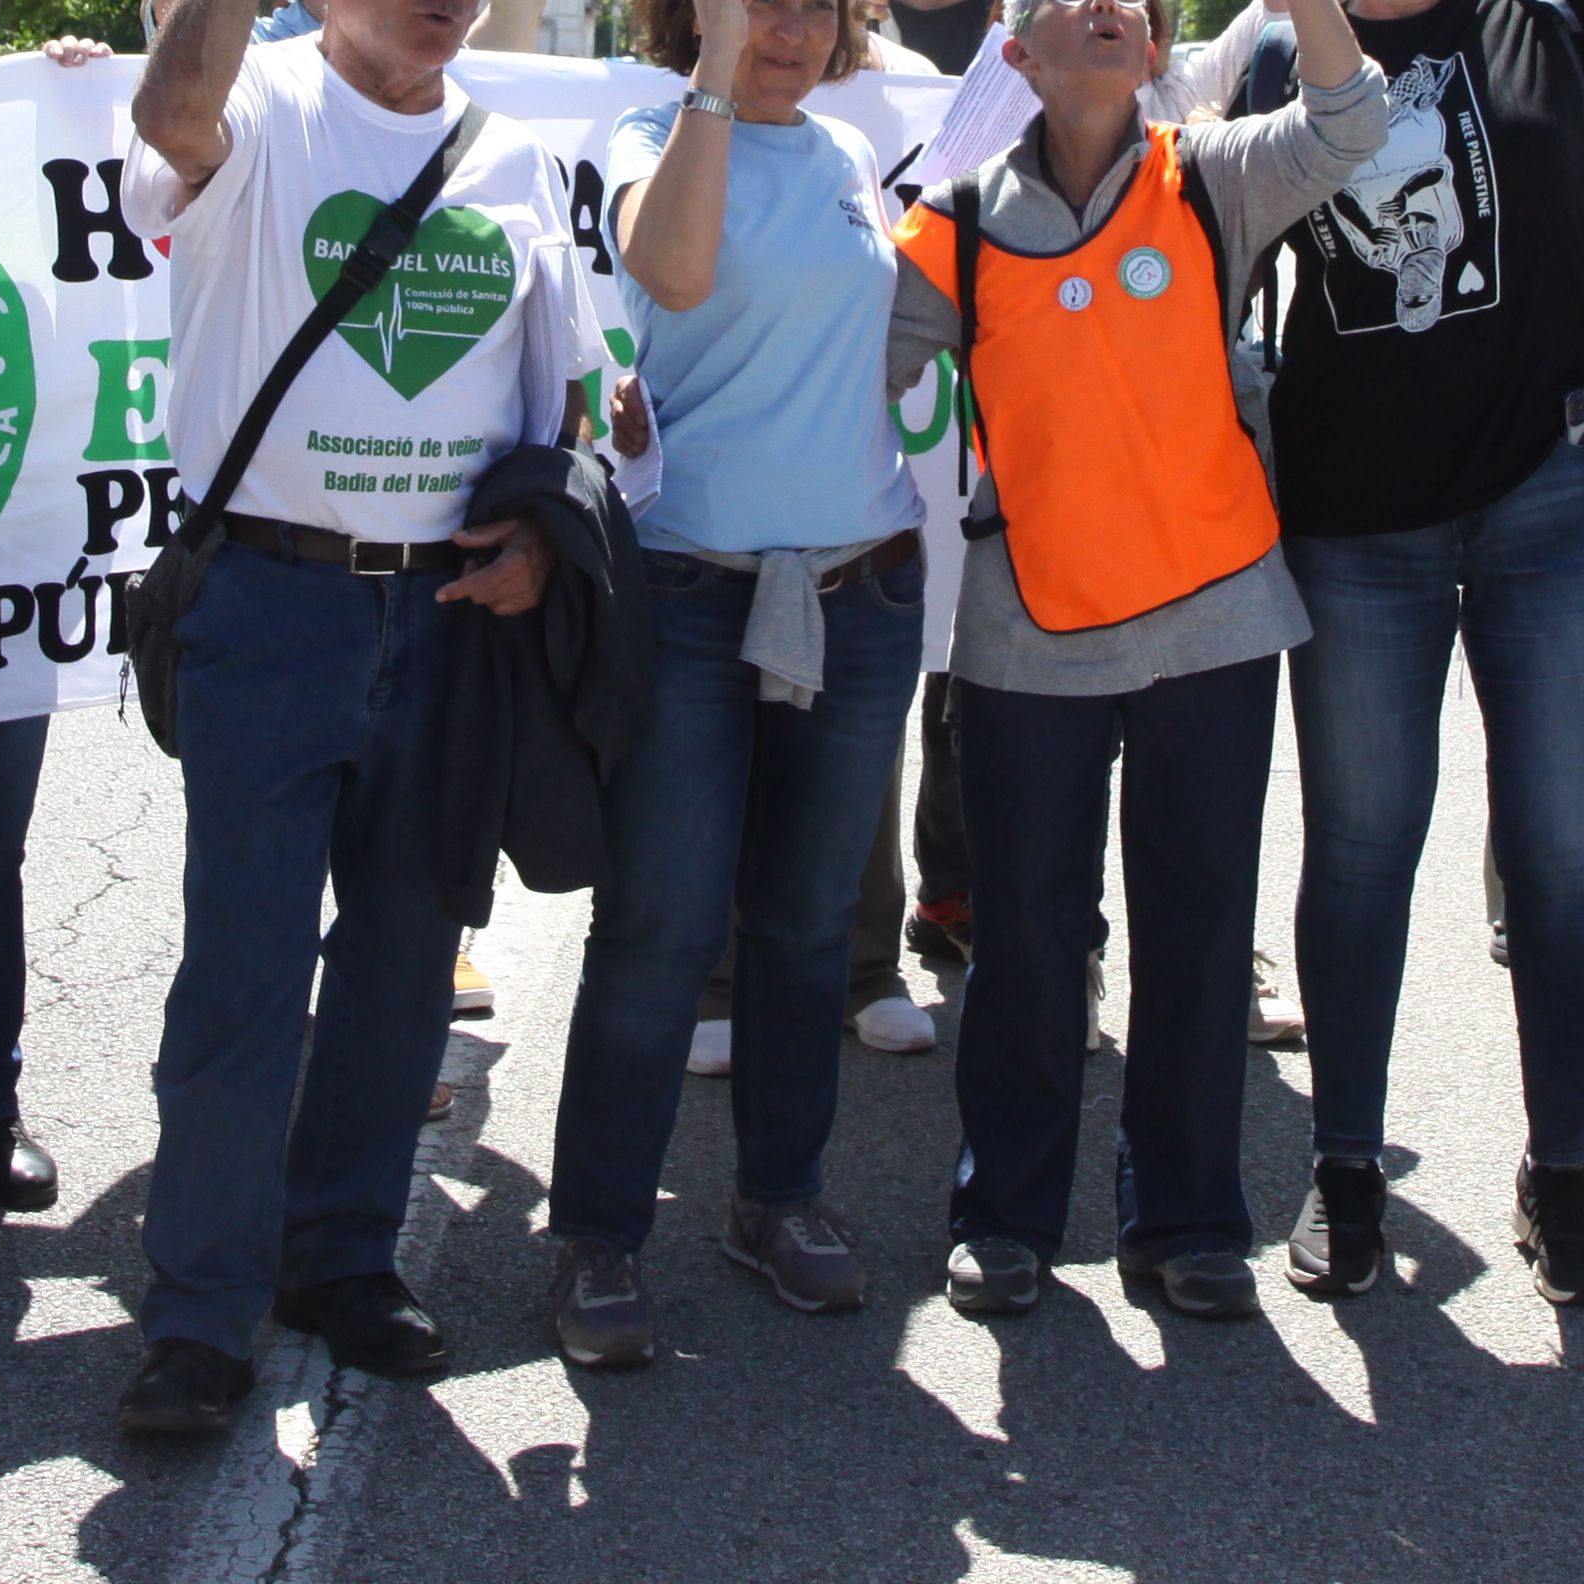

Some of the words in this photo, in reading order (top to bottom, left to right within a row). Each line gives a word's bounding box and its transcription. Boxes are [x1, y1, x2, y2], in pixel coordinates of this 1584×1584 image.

[1457, 110, 1475, 140] FREE
[1466, 138, 1492, 219] PALESTINE
[435, 253, 511, 279] VALLÈS
[404, 288, 453, 300] Comissió
[455, 289, 469, 300] de
[471, 290, 508, 303] Sanitat
[406, 301, 433, 312] 100%
[436, 302, 475, 315] pública
[307, 430, 414, 458] Associació
[419, 438, 442, 458] de
[447, 436, 484, 458] veïns
[324, 470, 377, 493] Badia
[382, 472, 413, 493] del
[417, 471, 464, 493] Vallès
